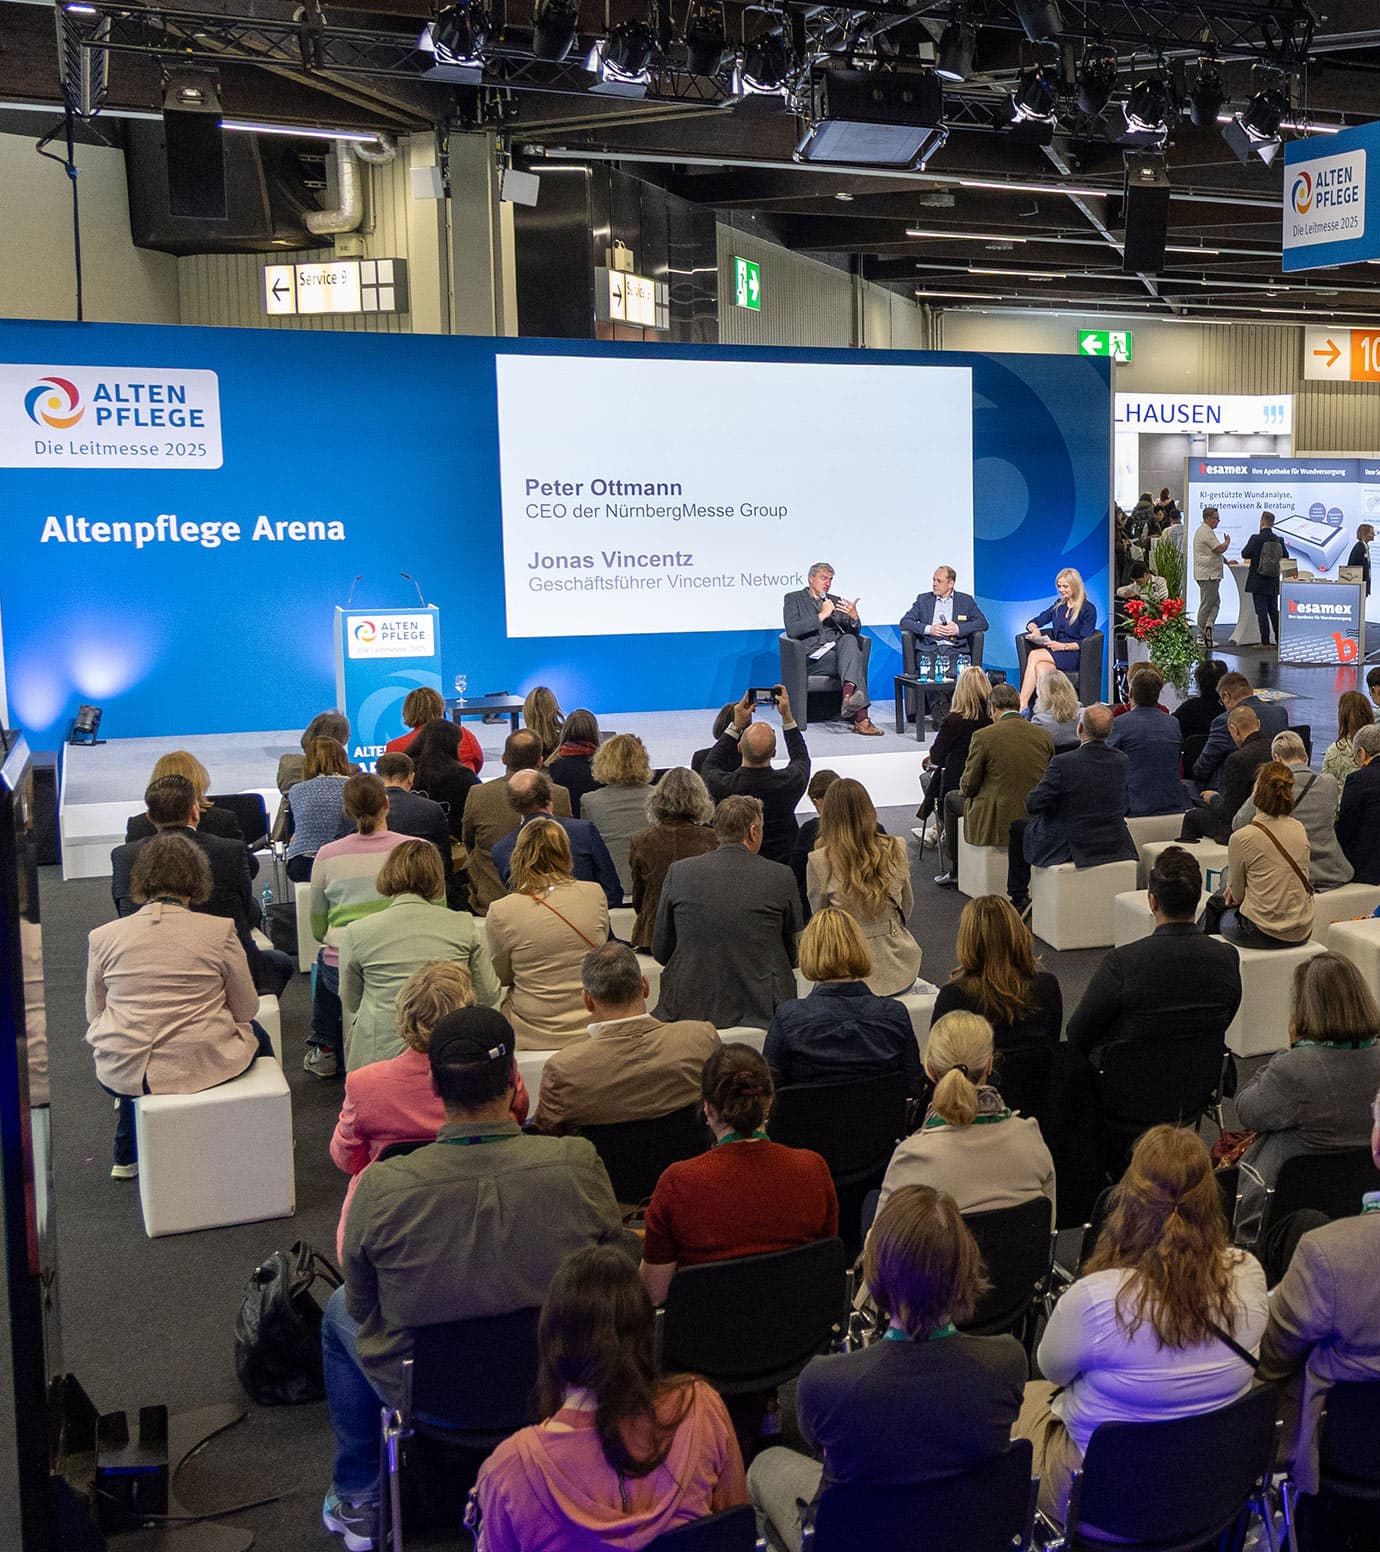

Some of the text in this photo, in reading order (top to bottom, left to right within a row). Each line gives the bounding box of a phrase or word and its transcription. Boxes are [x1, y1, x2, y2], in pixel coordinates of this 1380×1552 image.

[1316, 166, 1352, 189] ALTEN
[1316, 185, 1359, 208] PFLEGE
[1293, 216, 1359, 237] Die Leitmesse 2025
[300, 270, 337, 286] Service
[93, 383, 186, 404] ALTEN
[96, 407, 205, 428] PFLEGE
[1114, 403, 1221, 424] HAUSEN
[34, 440, 207, 457] Die Leitmesse 2025
[1200, 463, 1248, 475] besamex
[1264, 468, 1290, 476] Apotheke
[525, 478, 682, 496] Peter Ottmann
[1200, 491, 1293, 501] KI-gestützte Wundanalyse,
[526, 502, 788, 521] CEO der NürnbergMesse Group
[1256, 502, 1262, 510] &
[1264, 502, 1296, 511] Beratung
[41, 514, 346, 549] Altenpflege Arena
[528, 551, 694, 569] Jonas Vincentz
[529, 572, 803, 591] Geschäftsführer Vincentz Network
[1288, 599, 1352, 614] besamex
[381, 622, 418, 630] ALTEN
[382, 631, 425, 640] PFLEGE
